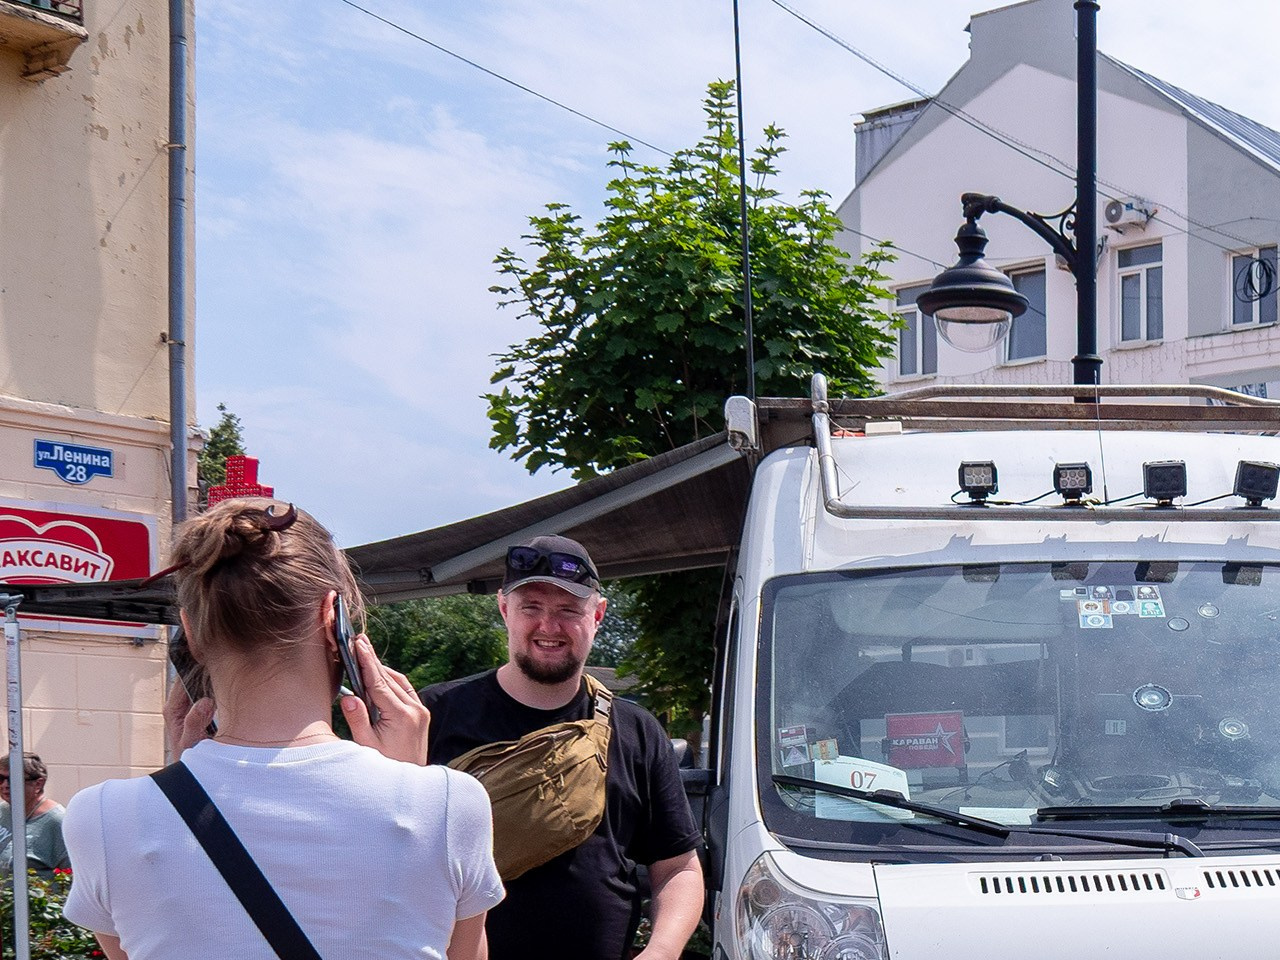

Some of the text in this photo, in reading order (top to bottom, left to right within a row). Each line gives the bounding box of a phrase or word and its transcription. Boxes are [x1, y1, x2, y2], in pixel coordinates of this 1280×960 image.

[66, 464, 87, 481] 28
[0, 550, 100, 579] АКСАВИТ
[892, 737, 939, 746] КАРАВАН
[850, 770, 877, 789] 07
